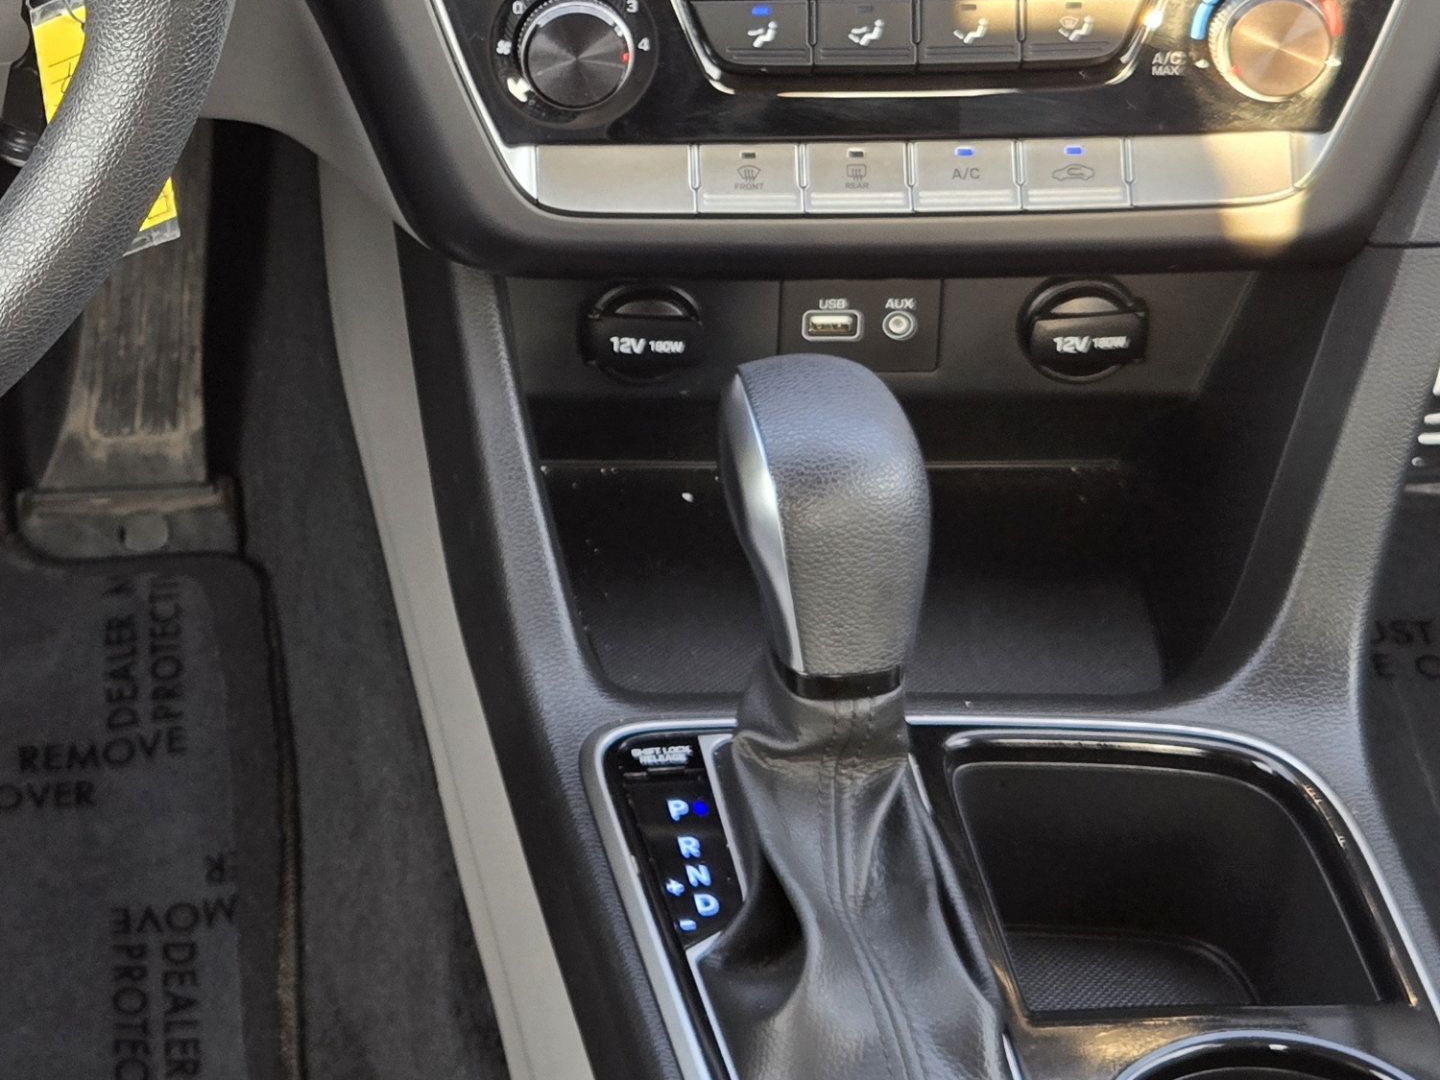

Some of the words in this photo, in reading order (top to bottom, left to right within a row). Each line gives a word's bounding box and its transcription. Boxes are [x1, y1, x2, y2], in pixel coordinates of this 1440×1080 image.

[512, 0, 525, 15] 0
[637, 37, 650, 52] 4
[1152, 51, 1185, 65] A/C
[1152, 65, 1182, 76] MAX
[951, 166, 981, 181] A/C
[734, 182, 764, 190] FRONT
[818, 298, 849, 310] USB
[884, 298, 915, 310] AUX
[610, 336, 646, 354] 12V
[1053, 336, 1091, 353] 12V
[17, 726, 188, 775] REMOVE
[667, 799, 689, 821] P
[677, 835, 701, 858] R
[685, 864, 711, 887] N
[694, 893, 720, 917] D
[162, 941, 202, 1077] DEALER
